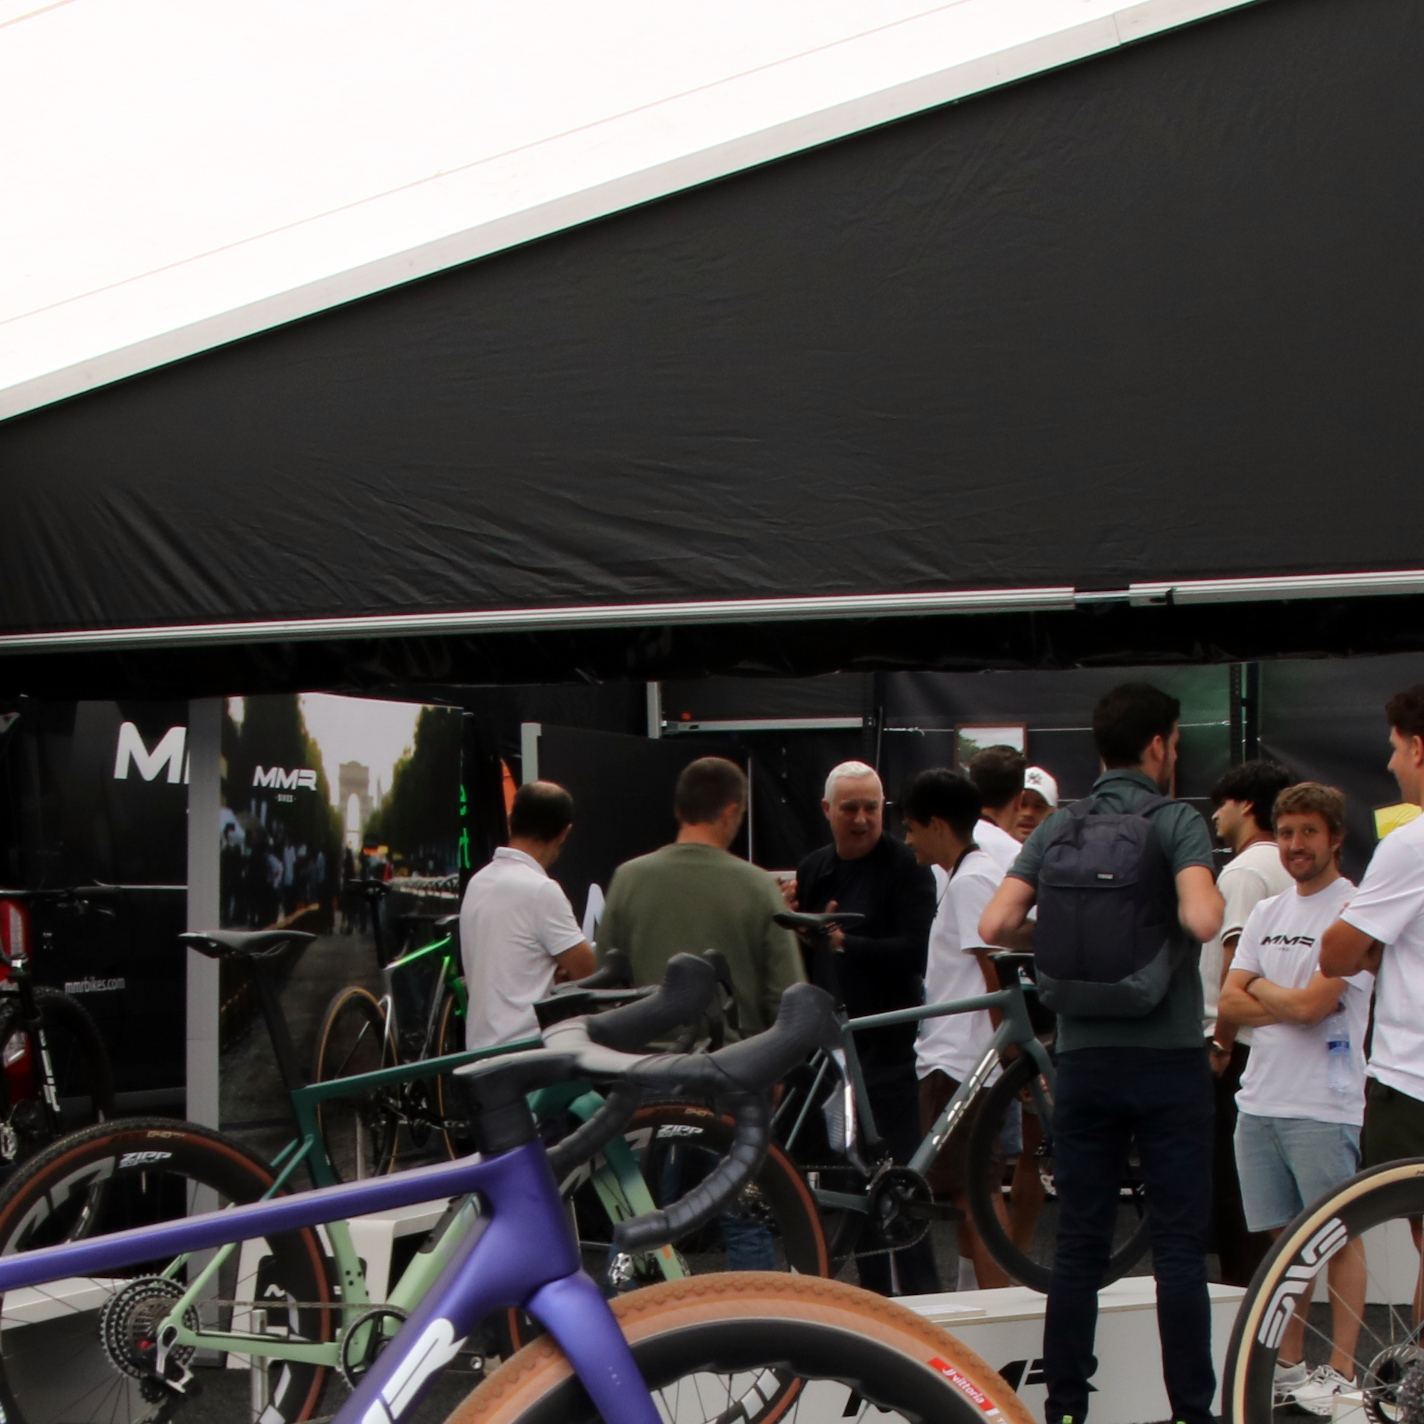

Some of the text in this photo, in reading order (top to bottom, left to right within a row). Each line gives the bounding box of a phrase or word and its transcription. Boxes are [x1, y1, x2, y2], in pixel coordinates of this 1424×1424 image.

[252, 765, 317, 792] MMR
[65, 976, 125, 994] mmrbikes.com
[660, 1124, 704, 1134] ZIPP
[121, 1151, 173, 1161] ZIPP
[951, 1374, 985, 1405] vittoria
